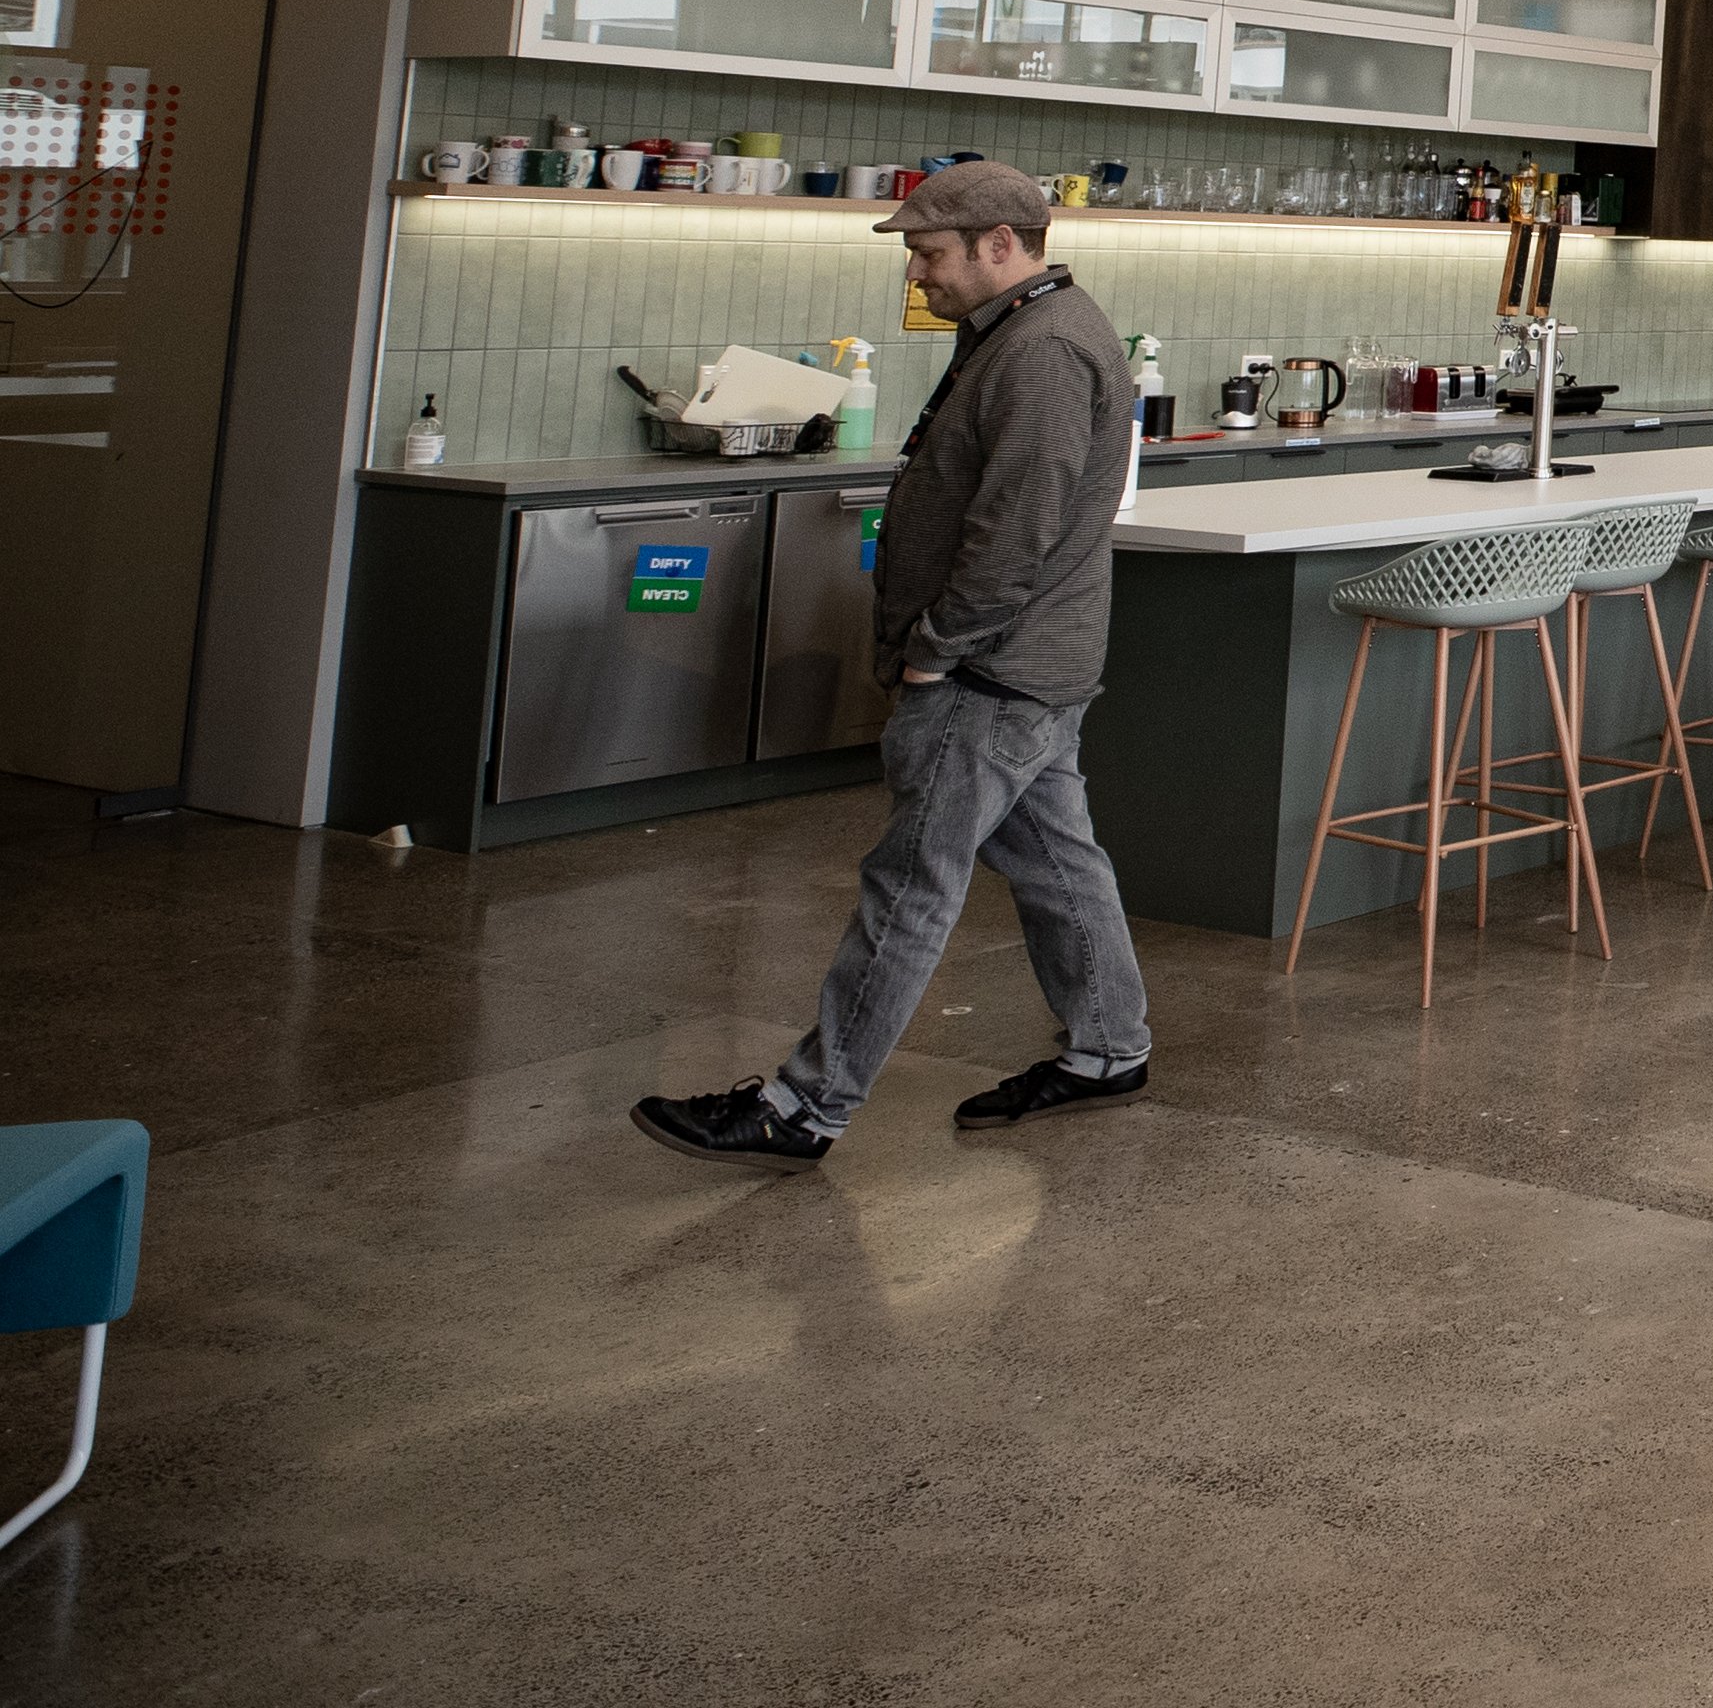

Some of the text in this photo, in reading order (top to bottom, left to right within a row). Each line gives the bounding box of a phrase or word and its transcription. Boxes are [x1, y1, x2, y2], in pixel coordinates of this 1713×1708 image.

[1029, 282, 1057, 297] Outset
[650, 557, 693, 570] DIRTY
[642, 589, 689, 601] CLEAN
